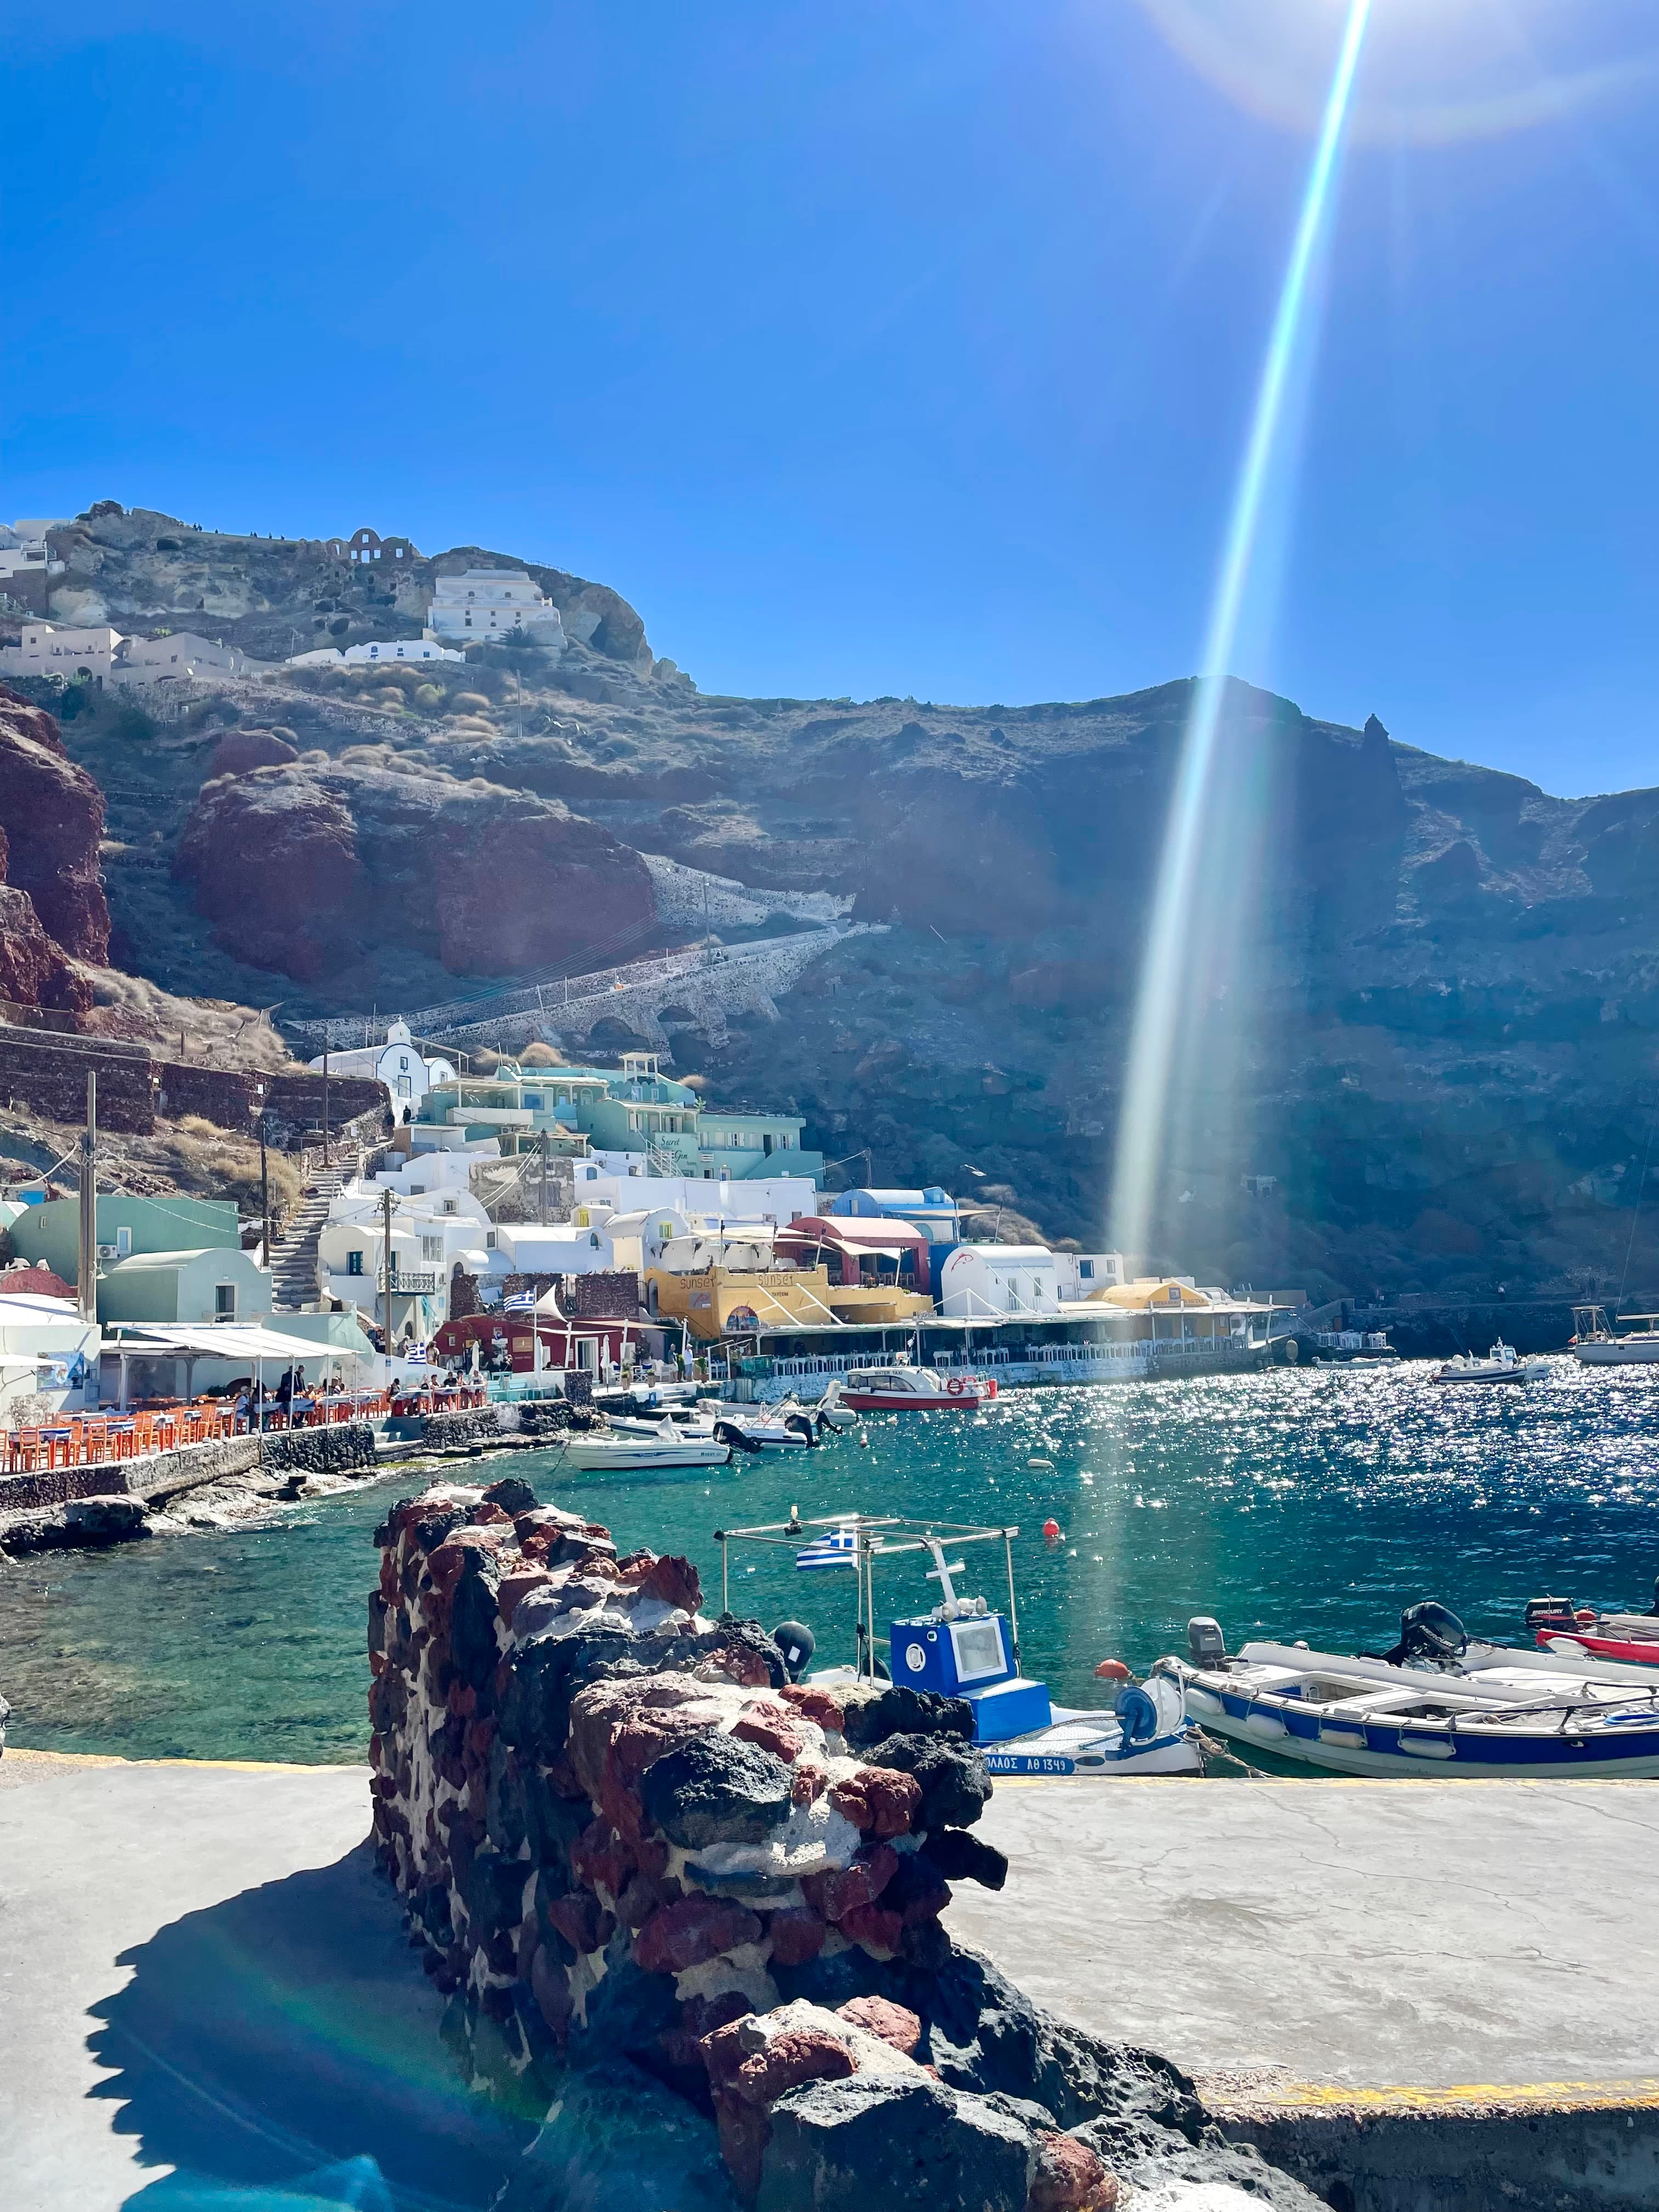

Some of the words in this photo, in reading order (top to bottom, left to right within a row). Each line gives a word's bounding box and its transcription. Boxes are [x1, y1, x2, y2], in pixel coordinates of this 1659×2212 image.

[1531, 1609, 1564, 1617] MERCURY
[1419, 1625, 1455, 1647] MERCURY
[1043, 1758, 1065, 1771] 1349
